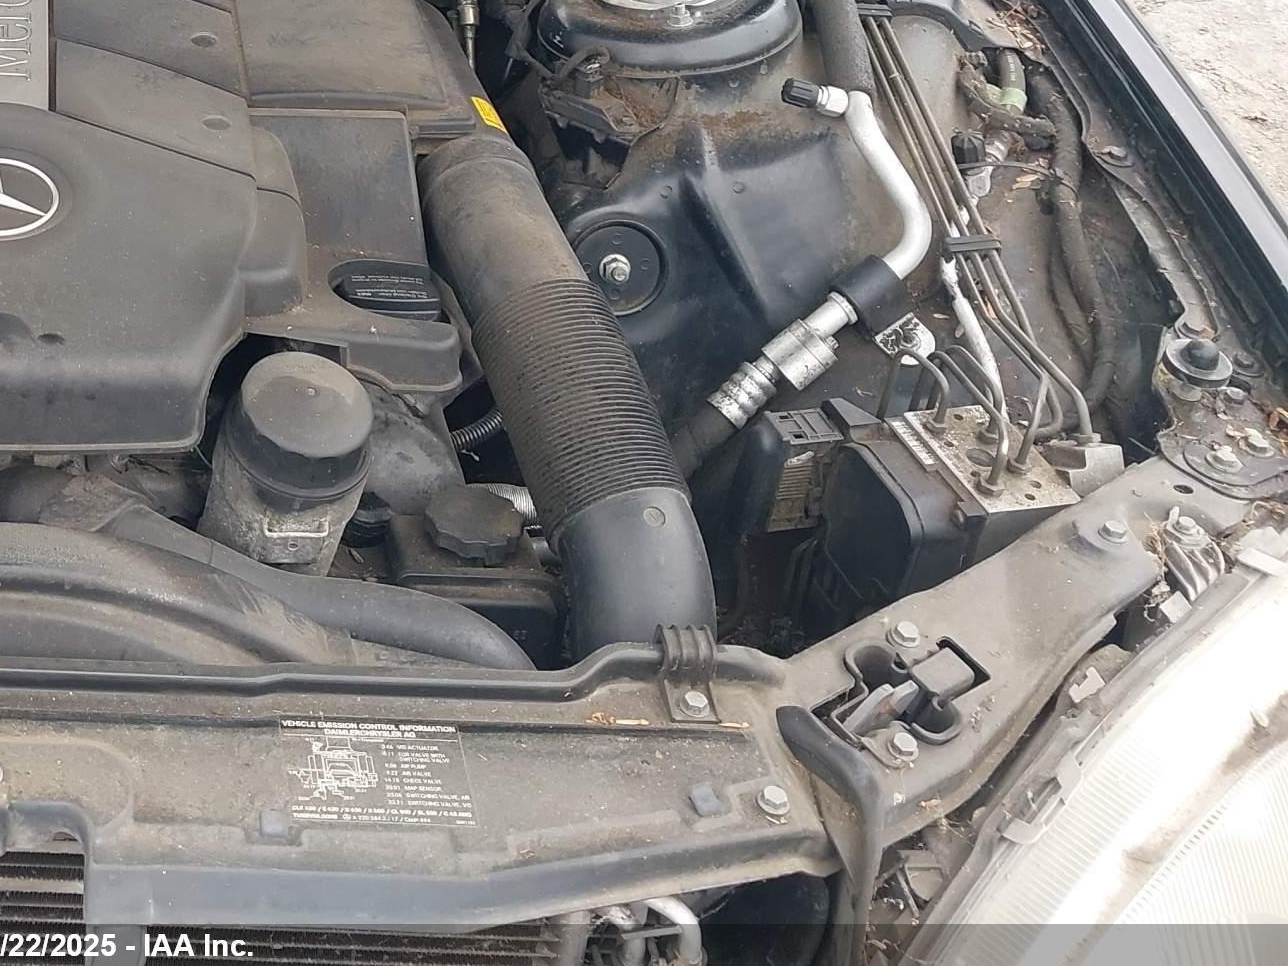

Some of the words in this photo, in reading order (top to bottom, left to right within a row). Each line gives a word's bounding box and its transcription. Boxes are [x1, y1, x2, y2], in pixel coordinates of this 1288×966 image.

[281, 720, 316, 728] VEHICLE
[318, 721, 358, 729] EMISSION
[359, 723, 398, 731] CONTROL
[399, 724, 456, 732] INFORMATION
[324, 728, 402, 737] DAIMLERCHRYSLER
